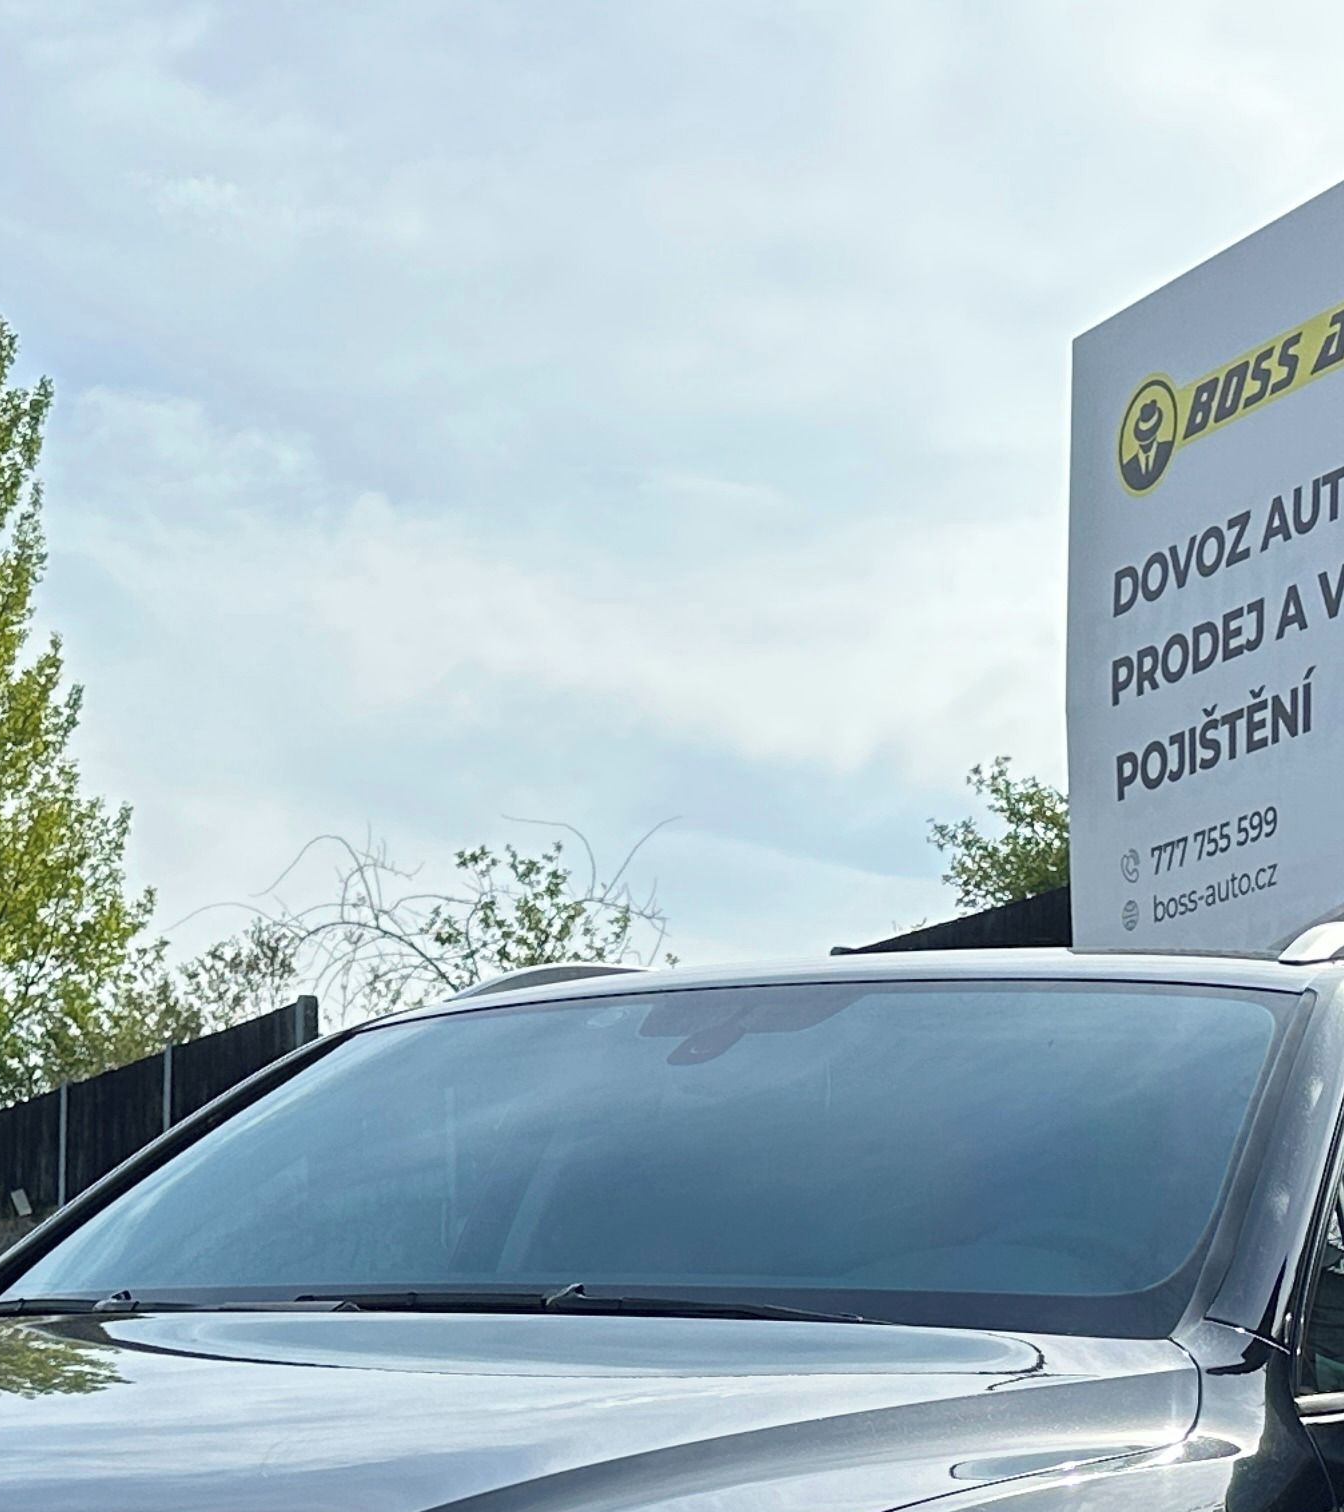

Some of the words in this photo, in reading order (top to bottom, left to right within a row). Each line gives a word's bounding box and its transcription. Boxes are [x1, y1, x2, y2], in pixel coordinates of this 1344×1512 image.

[1182, 331, 1303, 441] BOSS
[1112, 509, 1252, 618] DOVOZ
[1111, 597, 1265, 707] PRODEJ
[1275, 583, 1308, 641] A
[1115, 665, 1317, 802] POJIŠTĚNÍ
[1150, 835, 1189, 876] 777
[1193, 820, 1231, 862] 755
[1236, 806, 1278, 847] 599
[1153, 862, 1278, 924] boss-auto.cz
